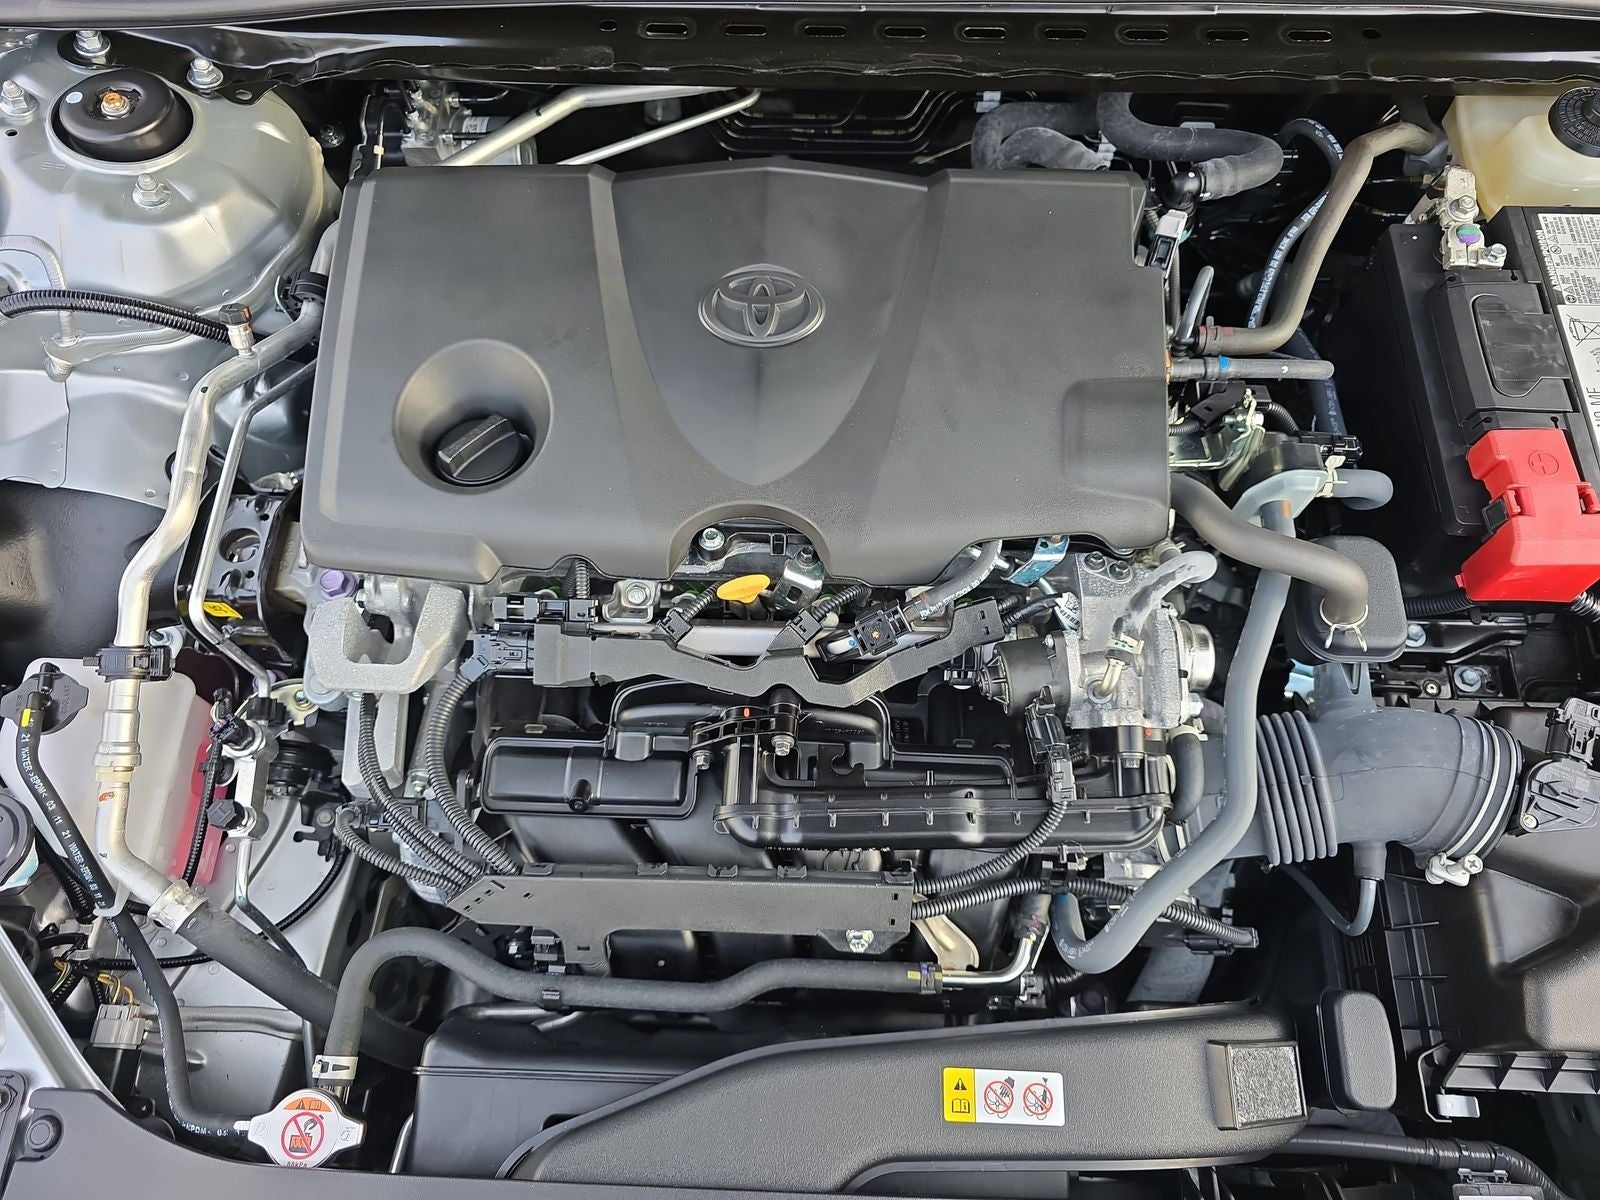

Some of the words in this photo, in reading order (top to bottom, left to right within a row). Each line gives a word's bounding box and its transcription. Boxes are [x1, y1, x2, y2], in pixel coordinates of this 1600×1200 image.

[21, 747, 33, 772] WATER
[61, 829, 72, 840] 21
[68, 842, 84, 864] WATER
